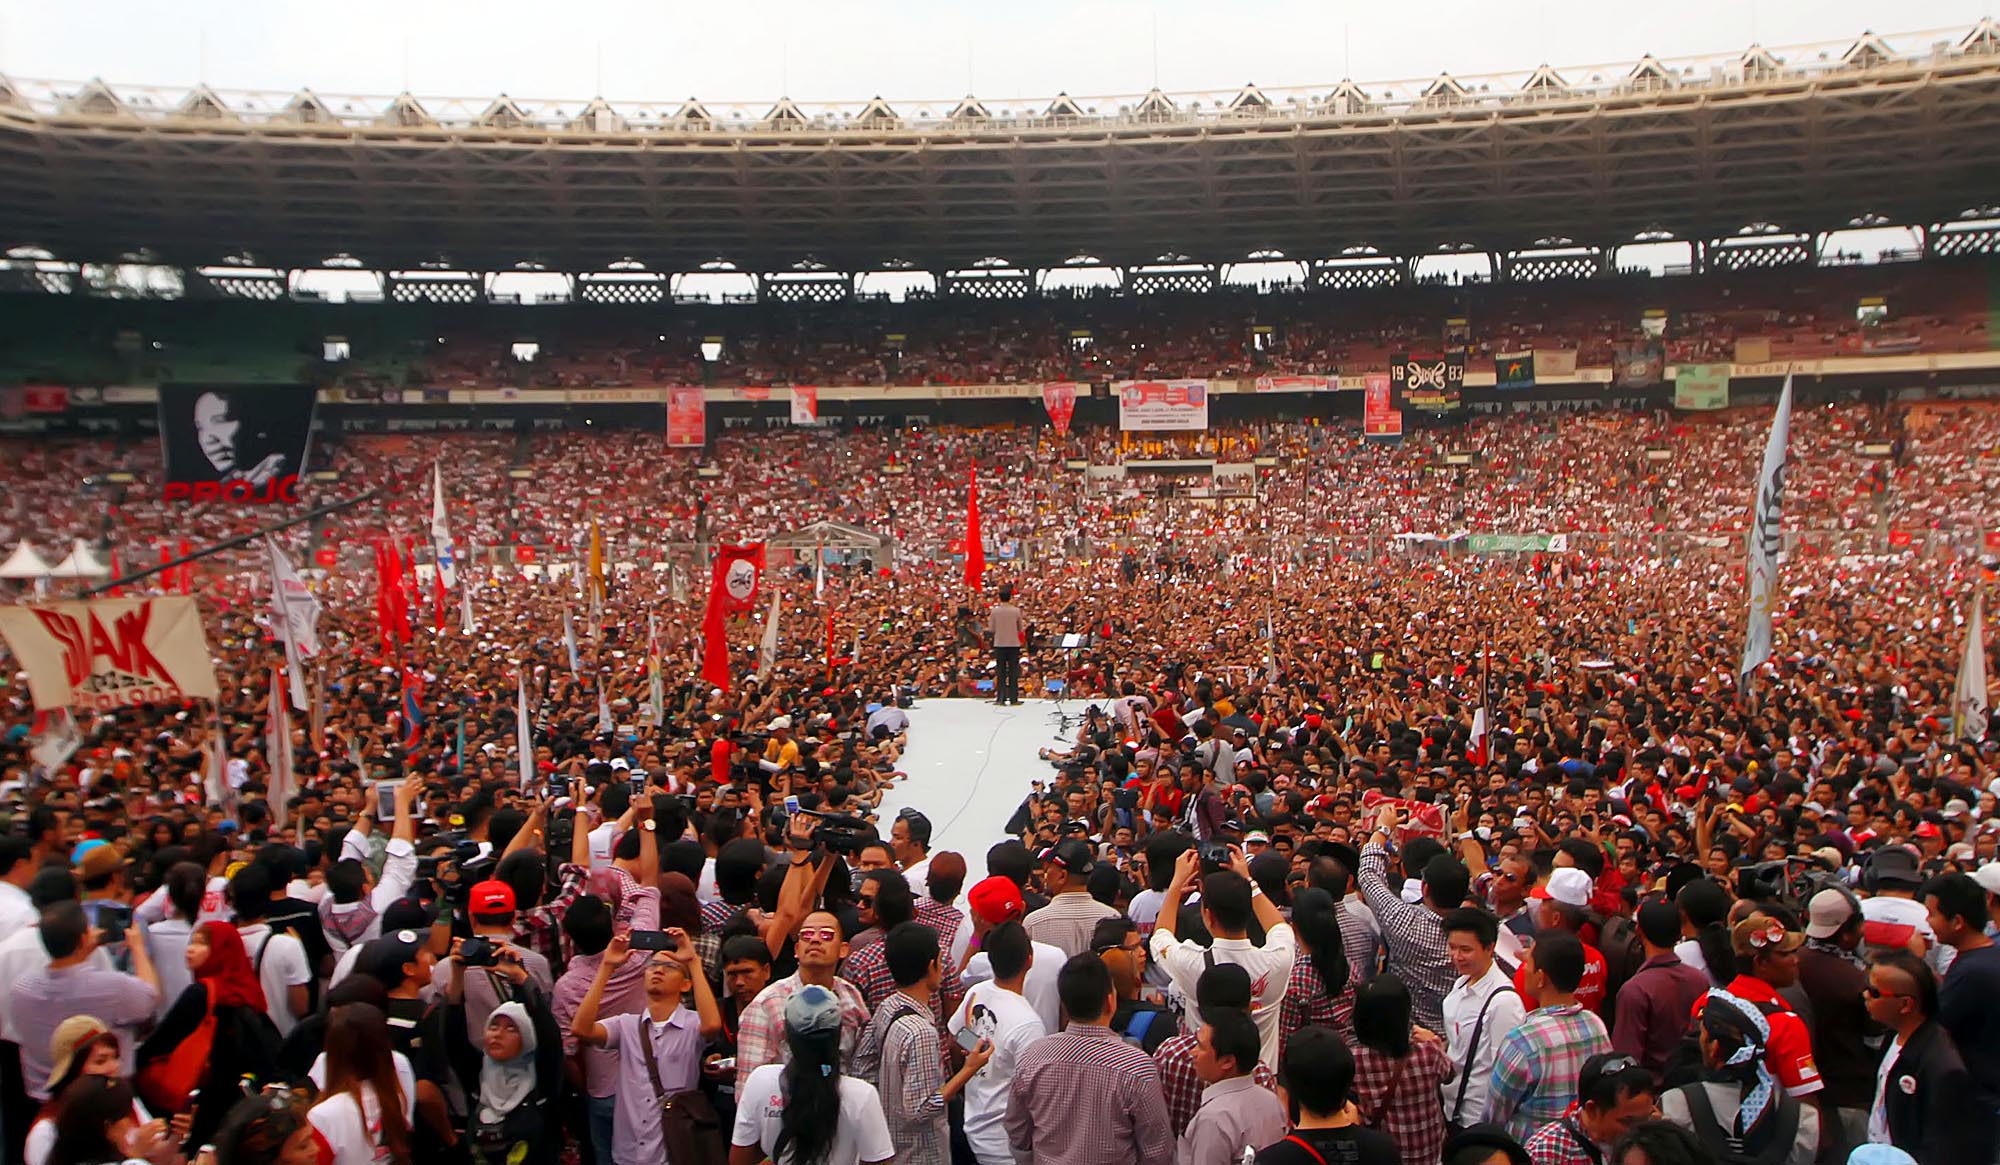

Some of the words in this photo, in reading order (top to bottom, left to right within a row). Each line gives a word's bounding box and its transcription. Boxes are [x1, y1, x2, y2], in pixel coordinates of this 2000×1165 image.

[1391, 365, 1404, 381] 19
[1448, 365, 1463, 381] 83
[951, 386, 1001, 396] SEKTOR
